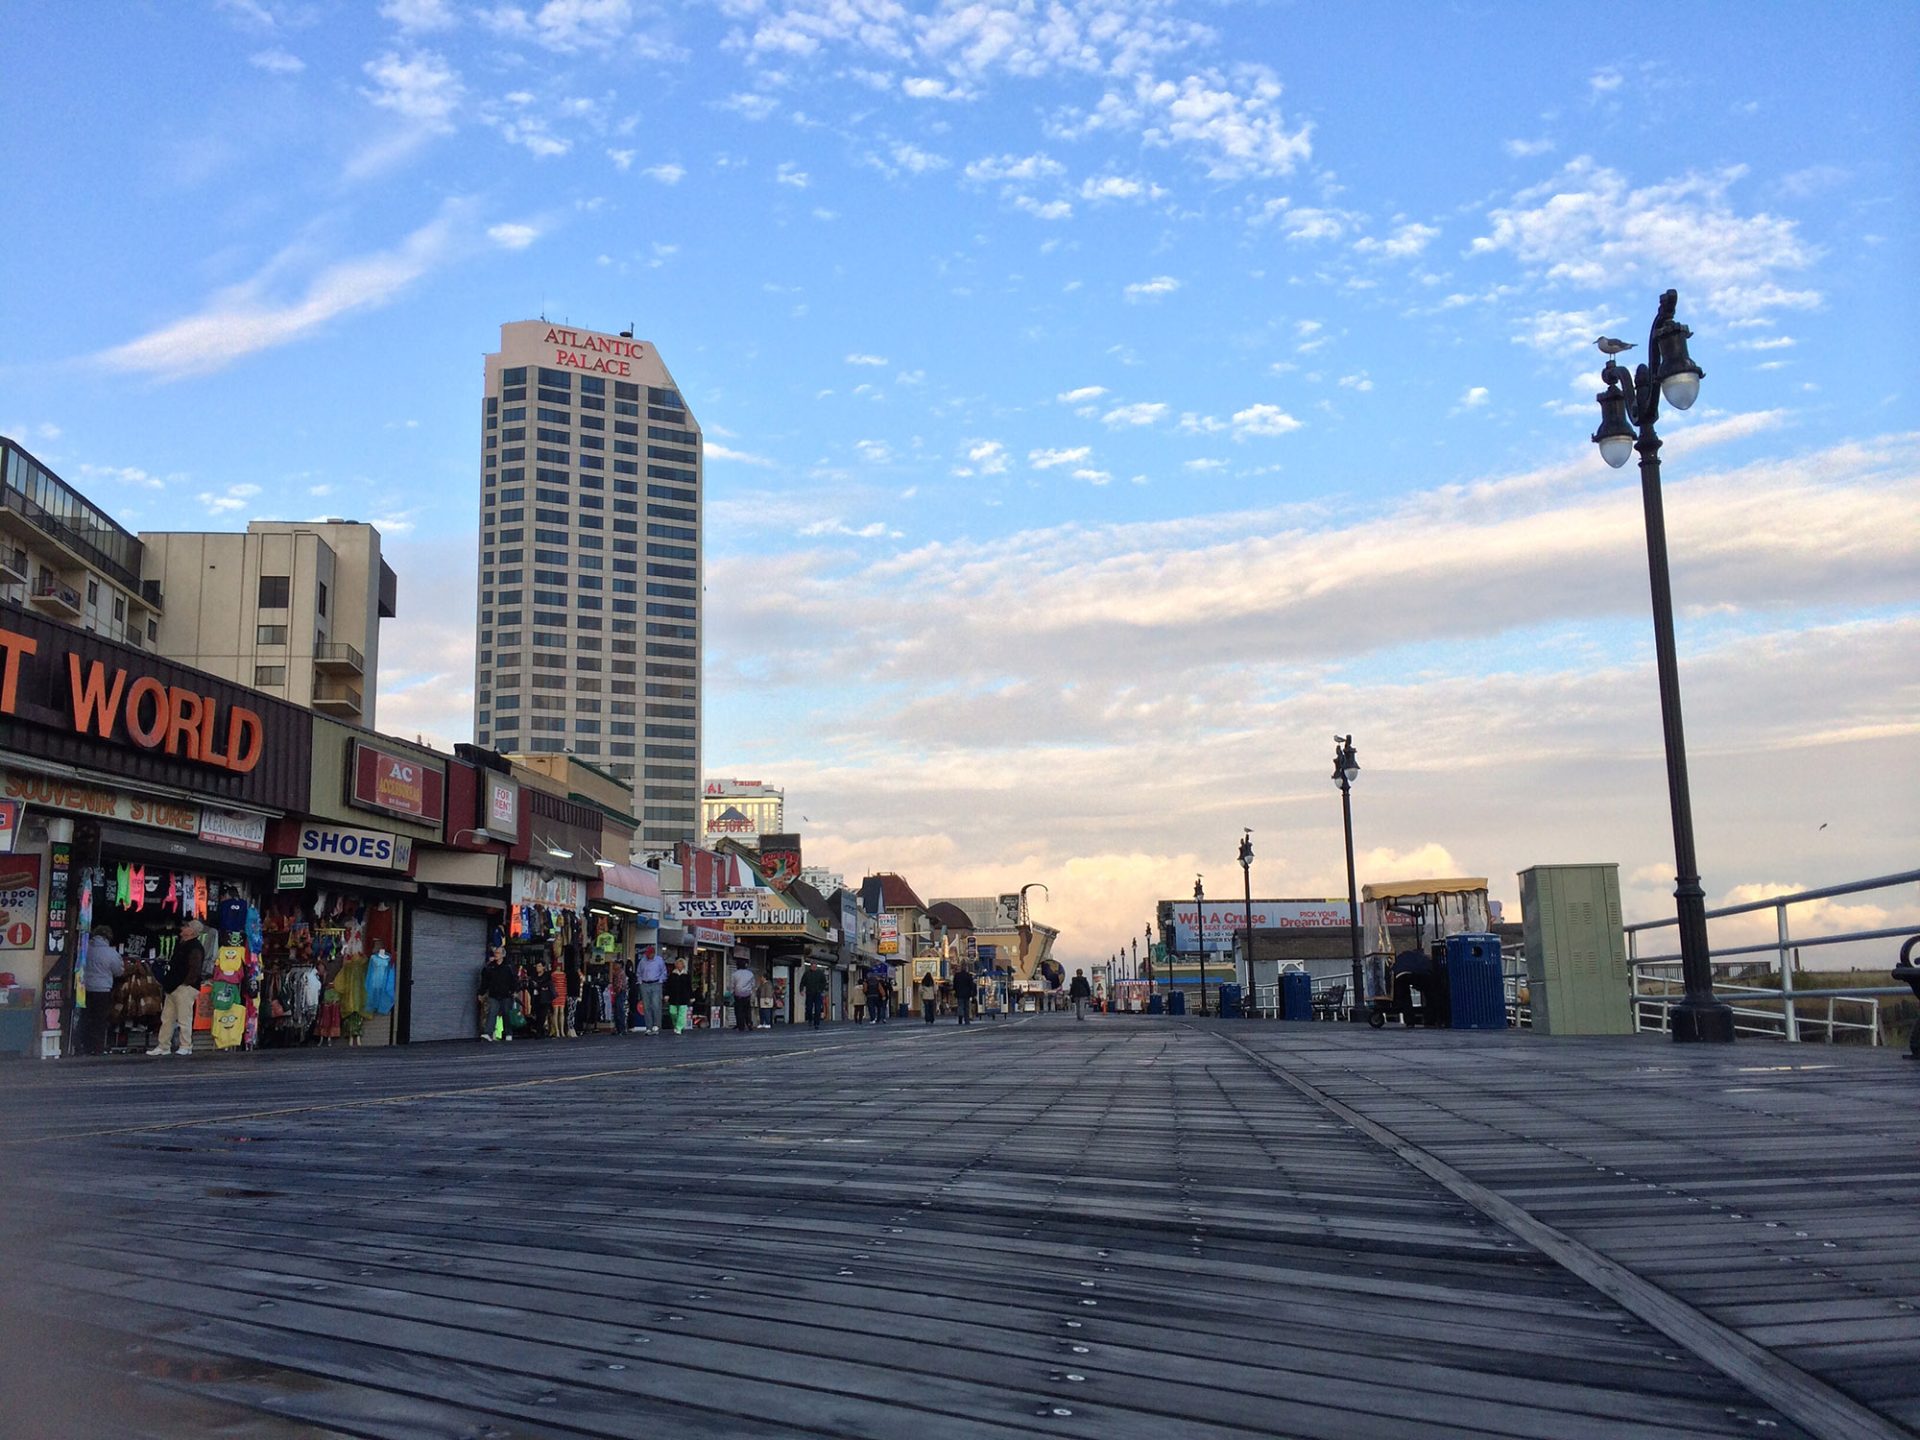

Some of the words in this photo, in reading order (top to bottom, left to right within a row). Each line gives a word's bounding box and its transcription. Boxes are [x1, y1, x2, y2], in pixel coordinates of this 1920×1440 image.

[544, 328, 644, 360] ATLANTIC
[556, 349, 632, 377] PALACE
[0, 628, 37, 714] T
[68, 652, 264, 773] WORLD
[390, 763, 413, 783] AC
[496, 788, 509, 800] FOR
[5, 775, 116, 817] SOUVENIR
[130, 800, 195, 830] STORE
[495, 799, 511, 812] RENT
[302, 829, 391, 860] SHOES
[281, 864, 304, 874] ATM
[11, 890, 35, 898] DOG
[678, 901, 718, 911] STEEL'S
[721, 900, 753, 911] FUDGE
[50, 909, 66, 920] GET
[770, 908, 810, 924] COURT
[1178, 912, 1207, 924] Win
[1210, 912, 1221, 924] A
[1224, 912, 1266, 924] Cruse
[1280, 917, 1320, 927] Dream
[1321, 916, 1352, 926] Cruis
